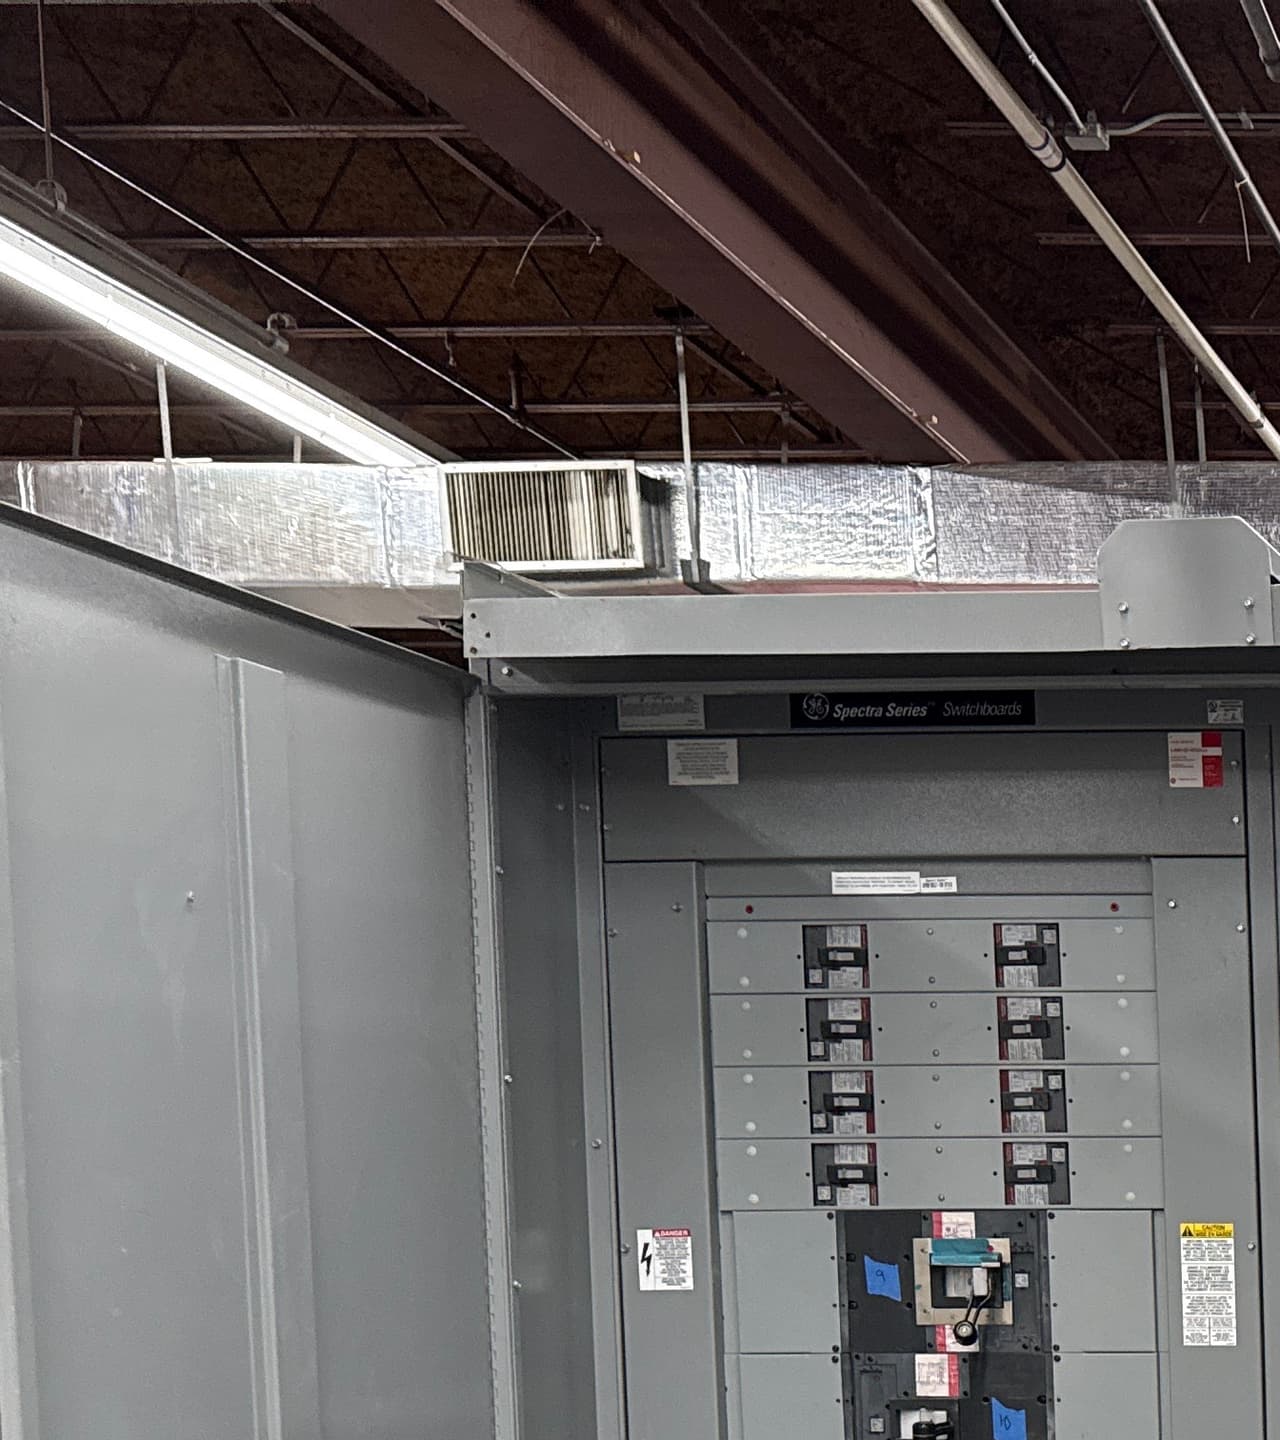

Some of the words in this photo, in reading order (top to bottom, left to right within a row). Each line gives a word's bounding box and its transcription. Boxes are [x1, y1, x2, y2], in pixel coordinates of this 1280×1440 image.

[832, 702, 883, 720] Spectra
[885, 702, 928, 718] Series
[942, 700, 1023, 717] Switchboards
[875, 1269, 887, 1282] 9
